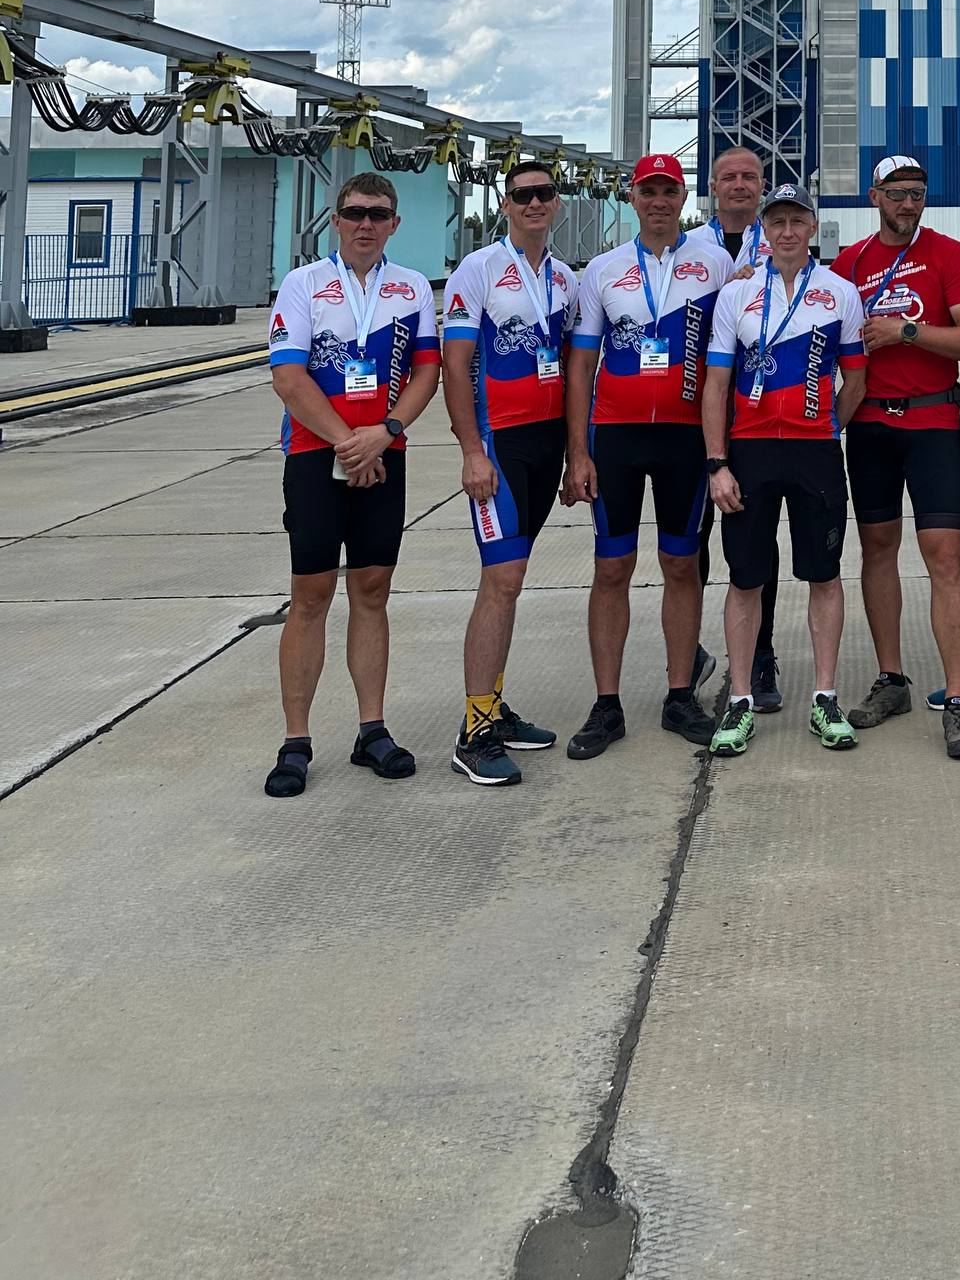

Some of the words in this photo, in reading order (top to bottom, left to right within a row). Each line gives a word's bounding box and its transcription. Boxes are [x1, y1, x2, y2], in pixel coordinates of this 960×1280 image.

[682, 299, 703, 402] ВЕЛОПРОБЕГ
[805, 325, 828, 419] ВЕЛОПРОБЕГ
[478, 499, 495, 540] ОФЖЕЛ
